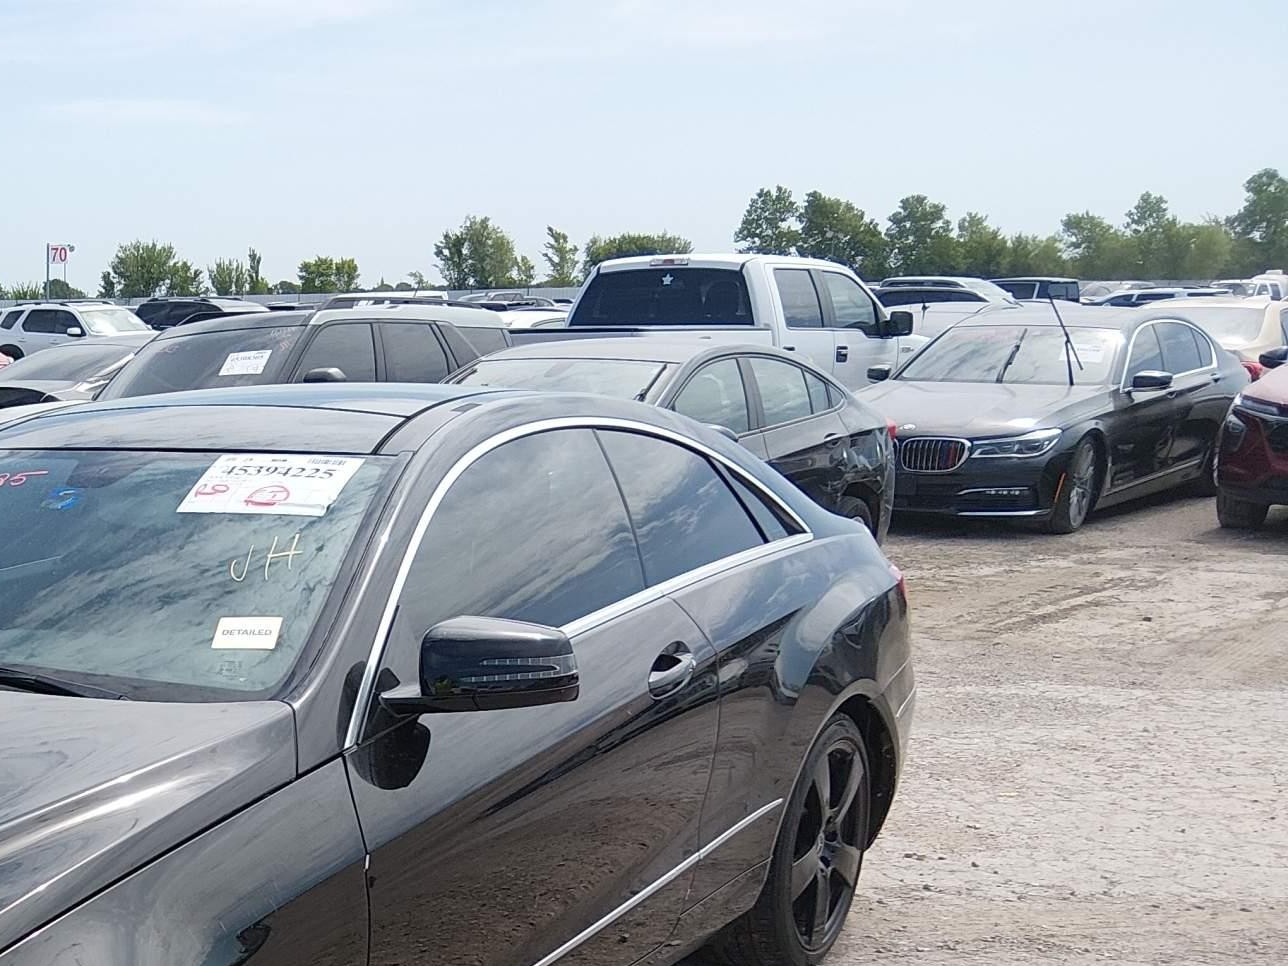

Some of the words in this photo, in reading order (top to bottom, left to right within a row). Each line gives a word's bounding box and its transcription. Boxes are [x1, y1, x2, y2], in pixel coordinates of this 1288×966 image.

[51, 247, 67, 262] 70
[220, 465, 337, 480] 45394225
[230, 533, 304, 582] JH
[222, 628, 273, 636] DETAILED
